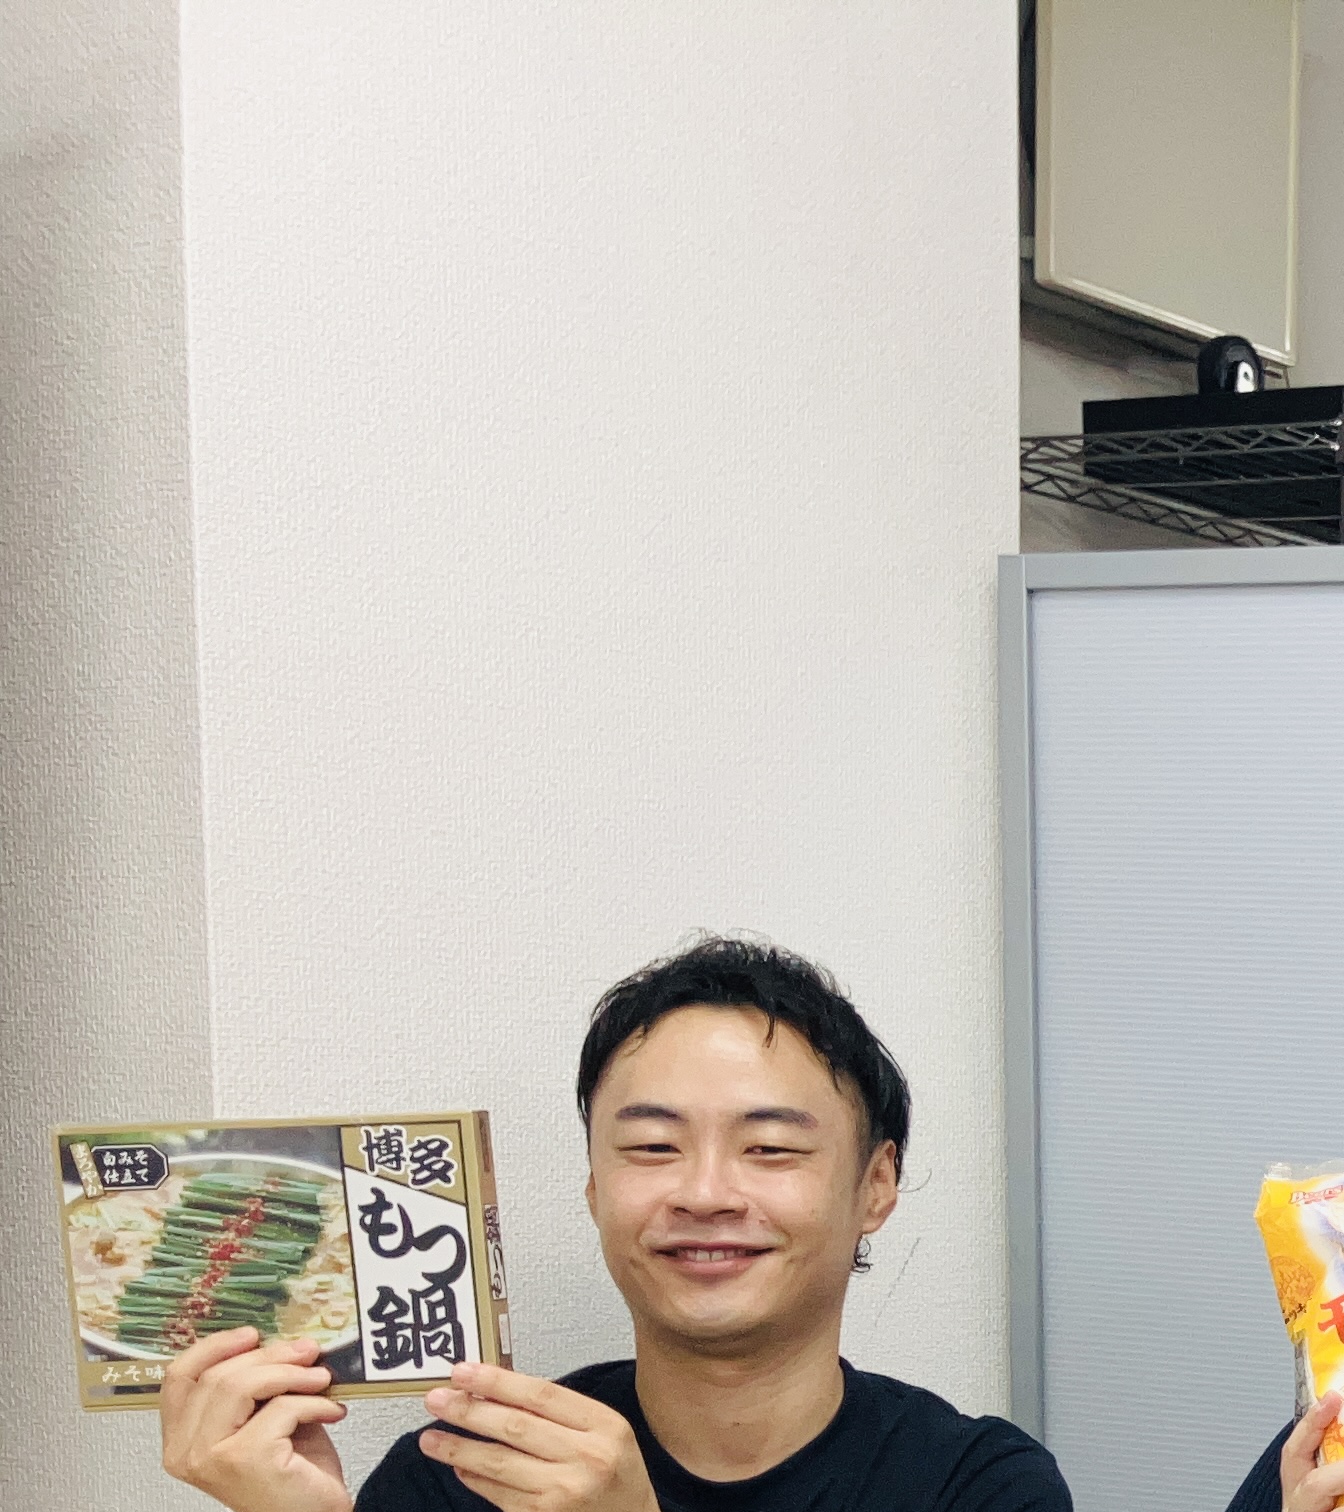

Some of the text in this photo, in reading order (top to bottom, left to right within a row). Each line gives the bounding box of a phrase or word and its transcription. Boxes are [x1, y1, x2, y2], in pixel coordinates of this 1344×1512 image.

[103, 1149, 148, 1166] 白みそ
[363, 1127, 455, 1186] 博多
[104, 1168, 149, 1184] 仕立て
[358, 1188, 467, 1371] もつ鍋
[102, 1364, 165, 1383] みそ味
